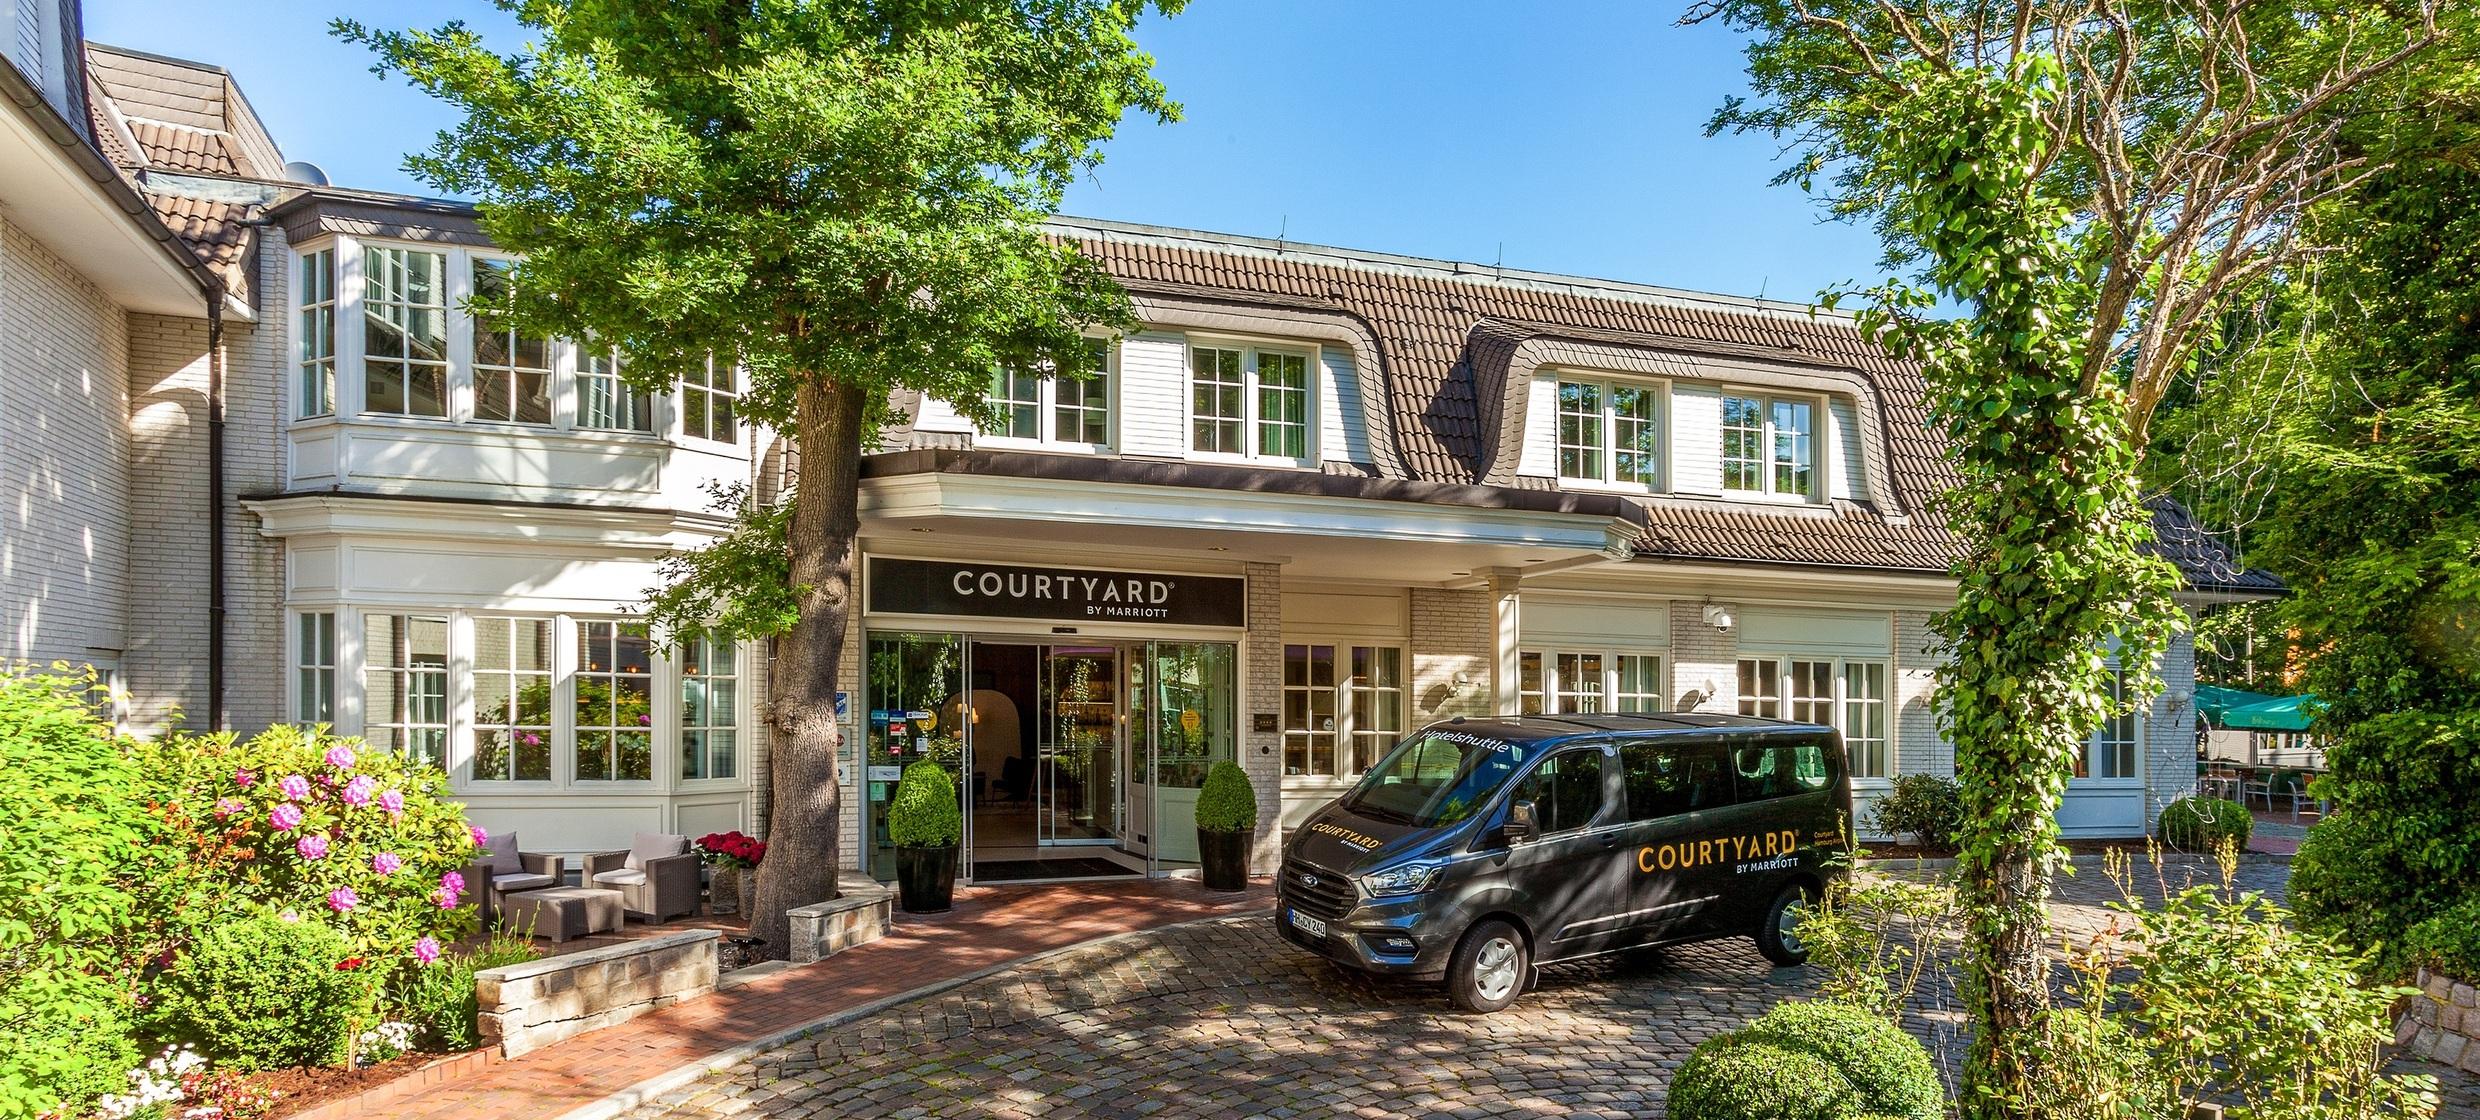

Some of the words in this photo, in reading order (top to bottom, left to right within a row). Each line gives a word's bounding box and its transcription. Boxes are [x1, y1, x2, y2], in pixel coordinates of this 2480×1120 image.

[1087, 606, 1102, 615] BY
[1106, 607, 1168, 618] MARRIOTT
[1419, 730, 1510, 753] Hotelshuttle
[1736, 863, 1748, 874] BY
[1750, 857, 1799, 872] MARRIOTT
